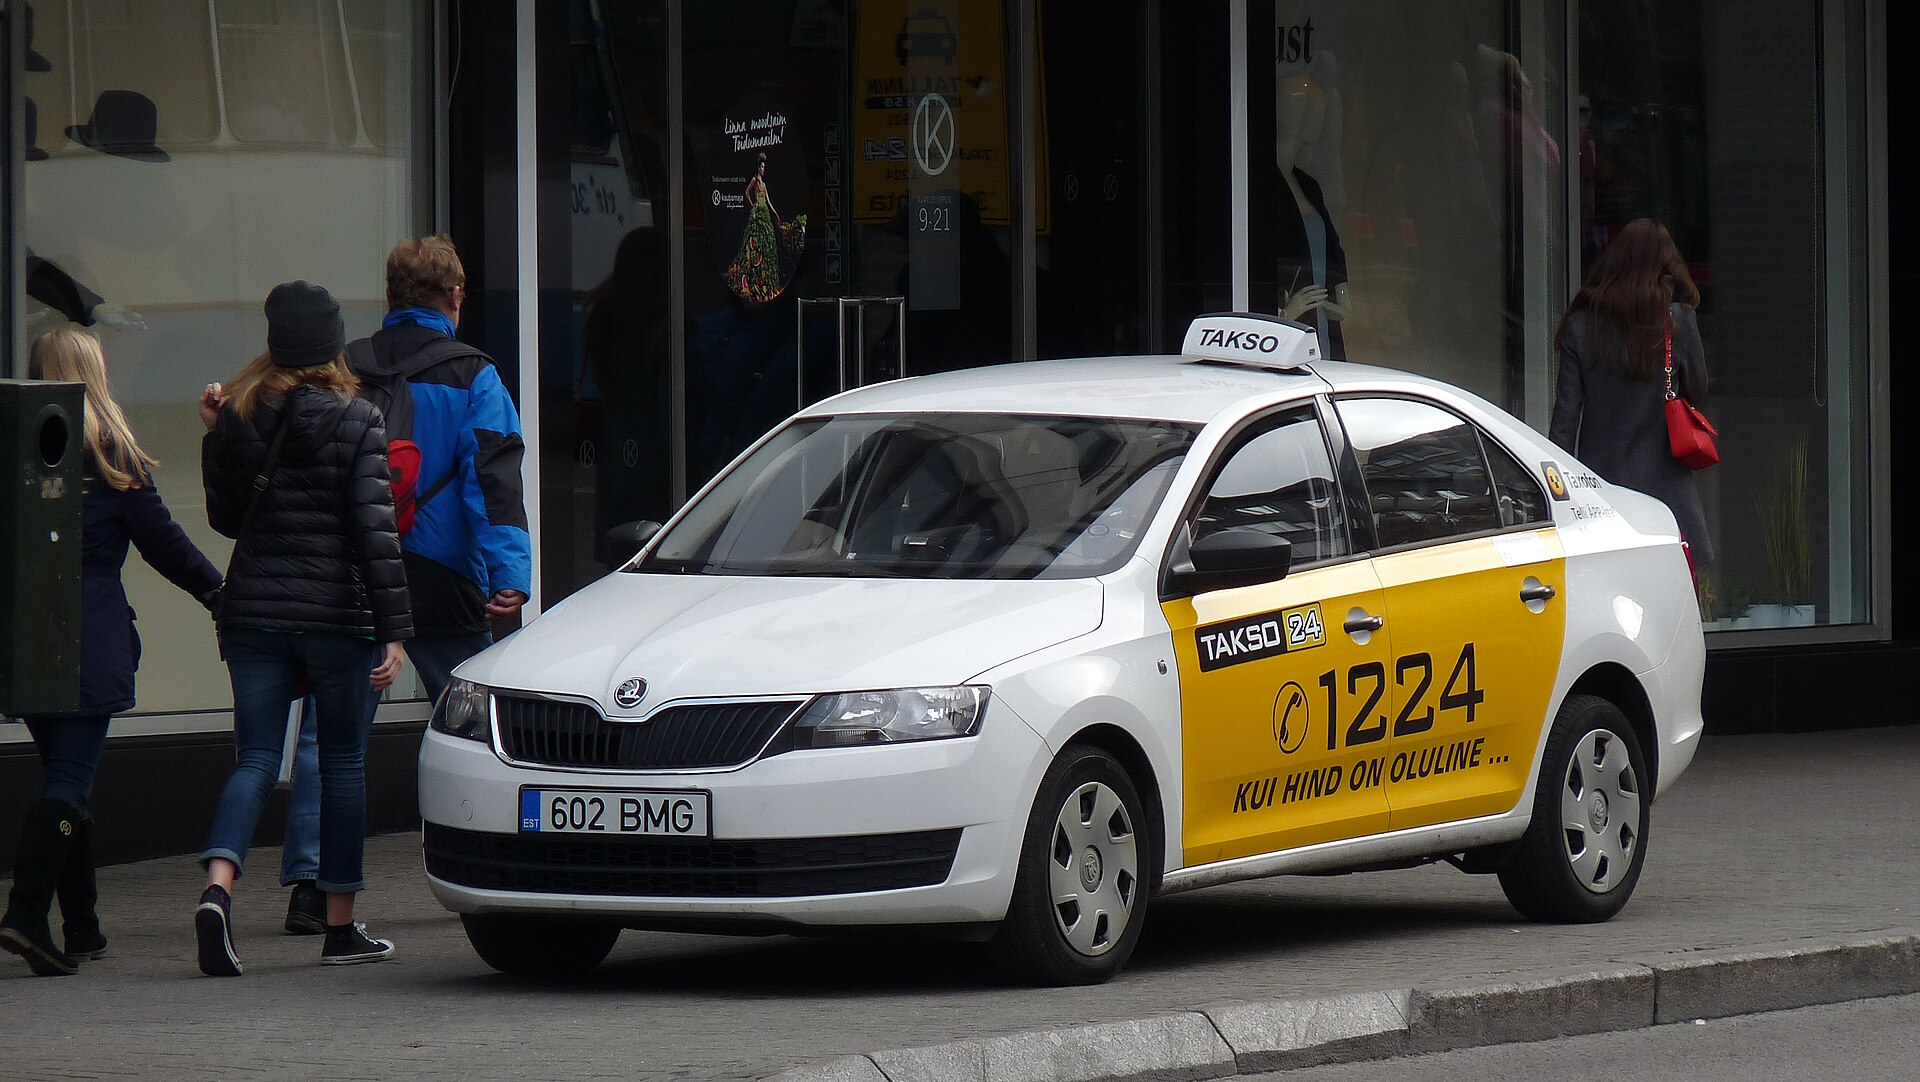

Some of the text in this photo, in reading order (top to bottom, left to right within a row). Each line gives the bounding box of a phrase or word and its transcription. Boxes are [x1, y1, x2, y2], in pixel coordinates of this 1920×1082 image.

[724, 117, 747, 135] Linna
[1200, 328, 1279, 353] TAKSO
[1200, 609, 1323, 661] TAKSO 24
[1318, 642, 1485, 751] 1224
[1233, 776, 1278, 814] KUI
[1282, 765, 1343, 804] HIND
[1350, 757, 1385, 791] ON
[1390, 737, 1486, 784] OLULINE
[523, 818, 539, 829] EST
[551, 796, 694, 833] 602 BMG
